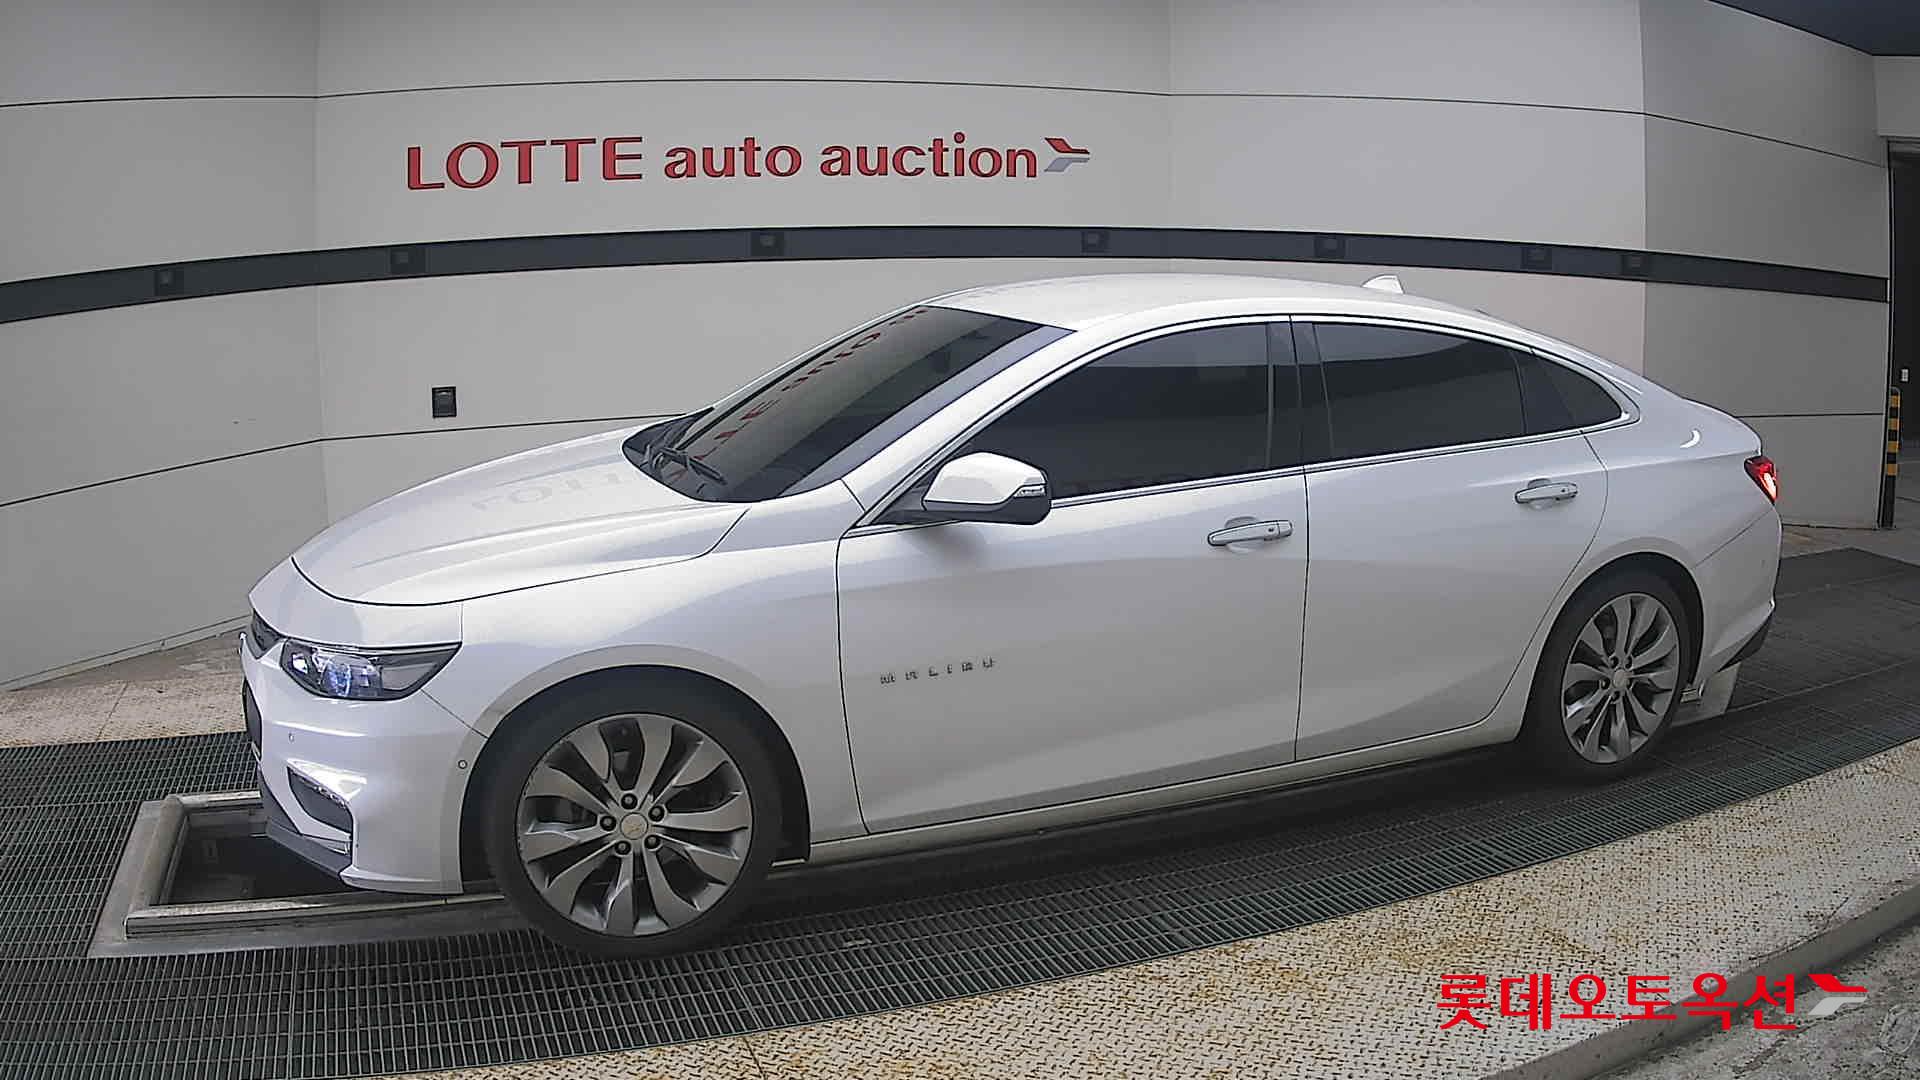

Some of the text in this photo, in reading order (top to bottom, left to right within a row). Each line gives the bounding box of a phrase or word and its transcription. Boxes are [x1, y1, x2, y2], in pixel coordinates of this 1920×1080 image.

[407, 132, 1038, 190] LOTTE auto auction
